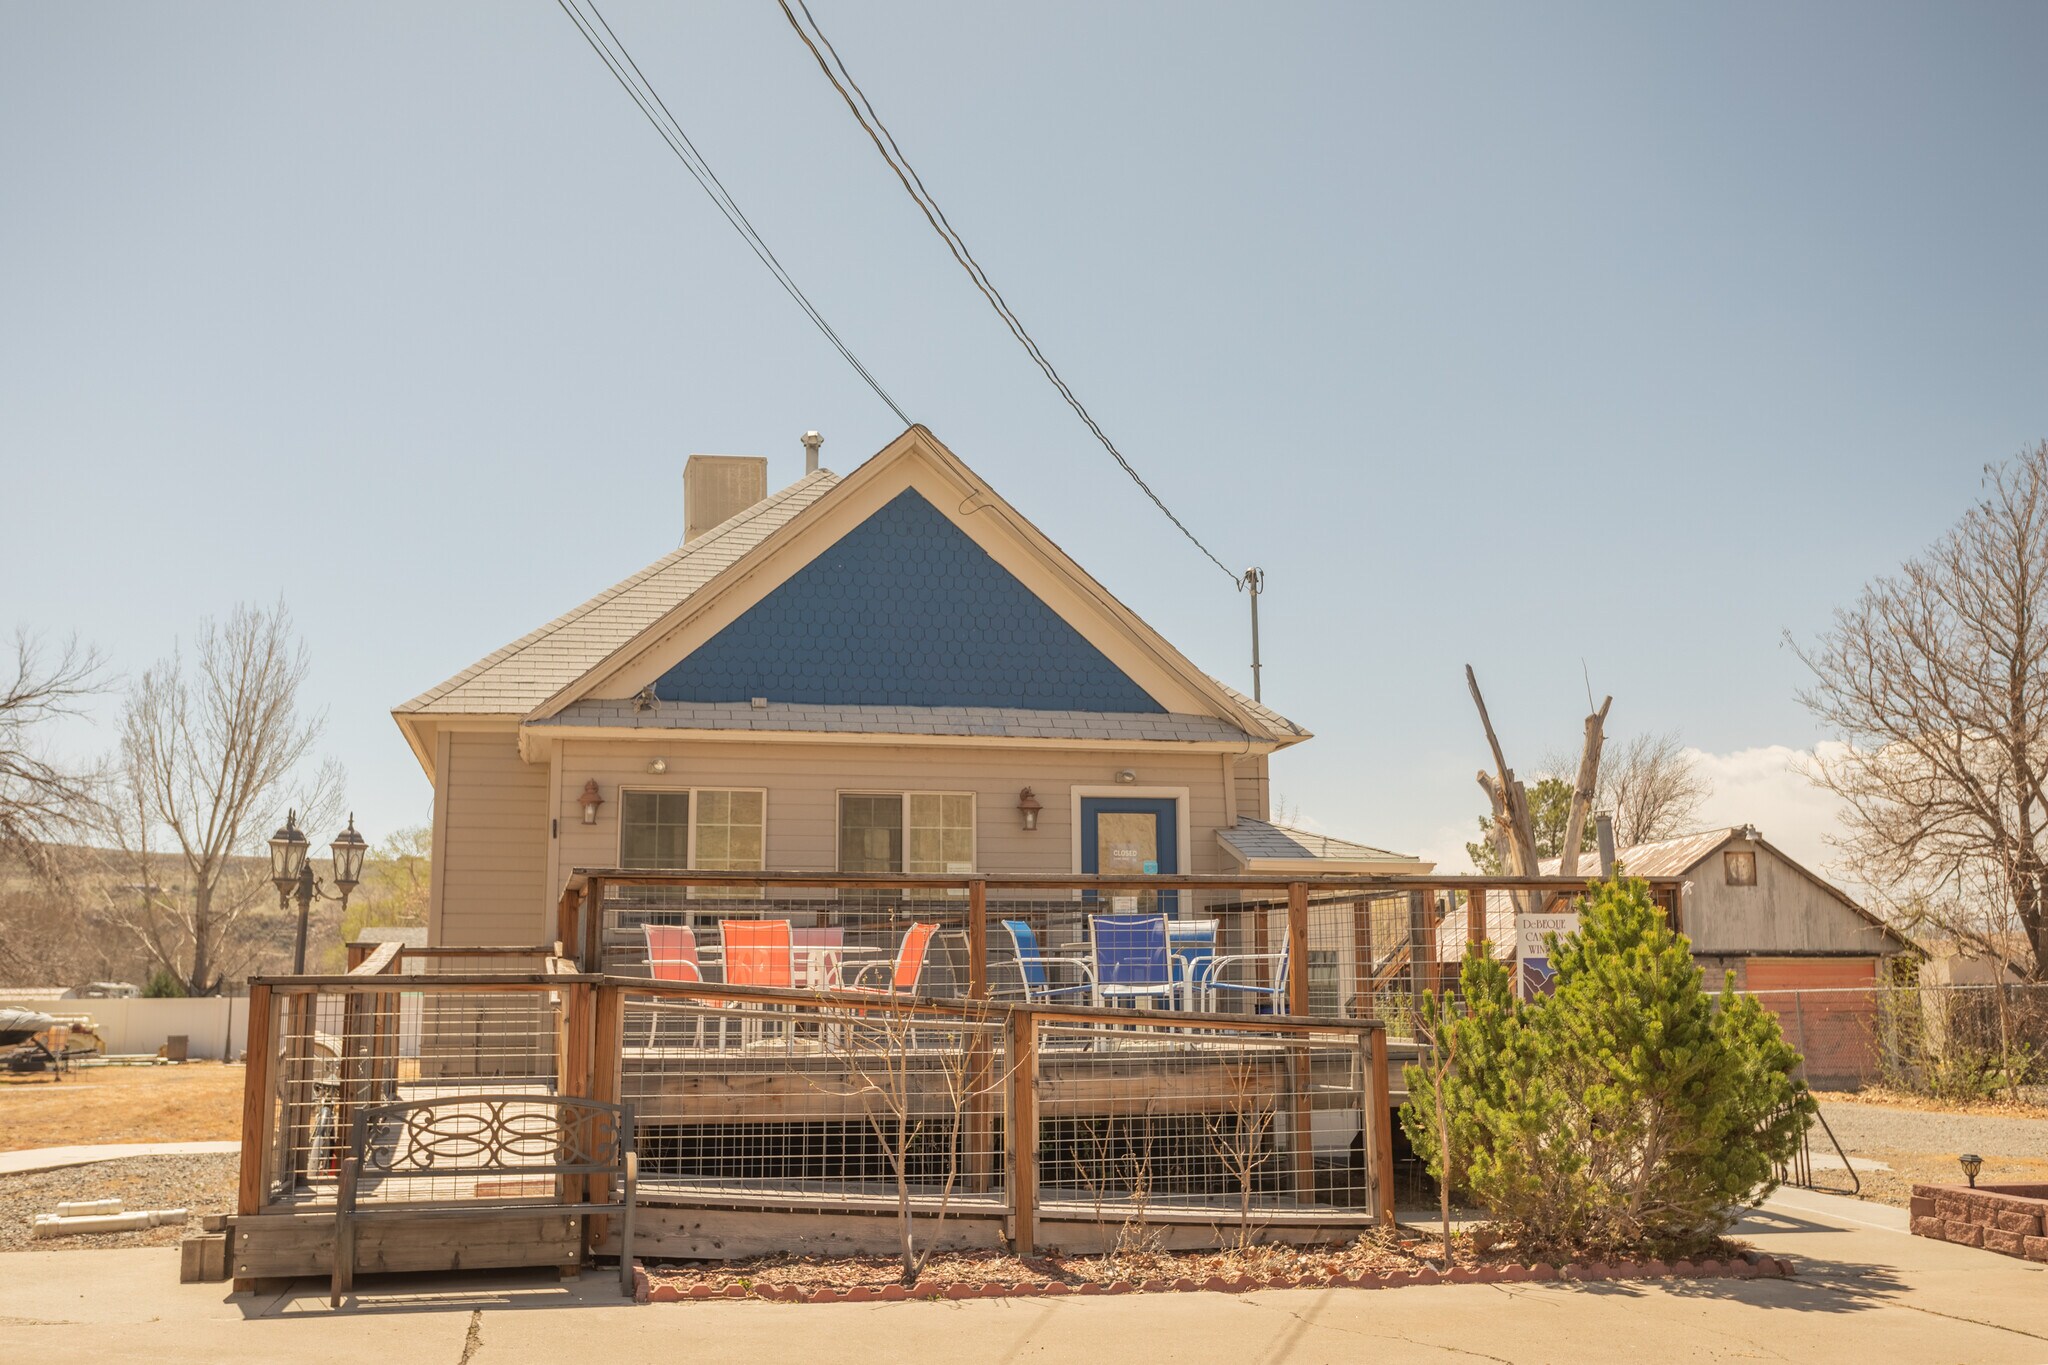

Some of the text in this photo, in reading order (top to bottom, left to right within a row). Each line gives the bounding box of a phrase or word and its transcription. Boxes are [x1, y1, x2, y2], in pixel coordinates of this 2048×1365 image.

[1113, 849, 1138, 857] CLOSED
[1523, 919, 1566, 930] DeBEQUE
[1525, 932, 1564, 942] CANN
